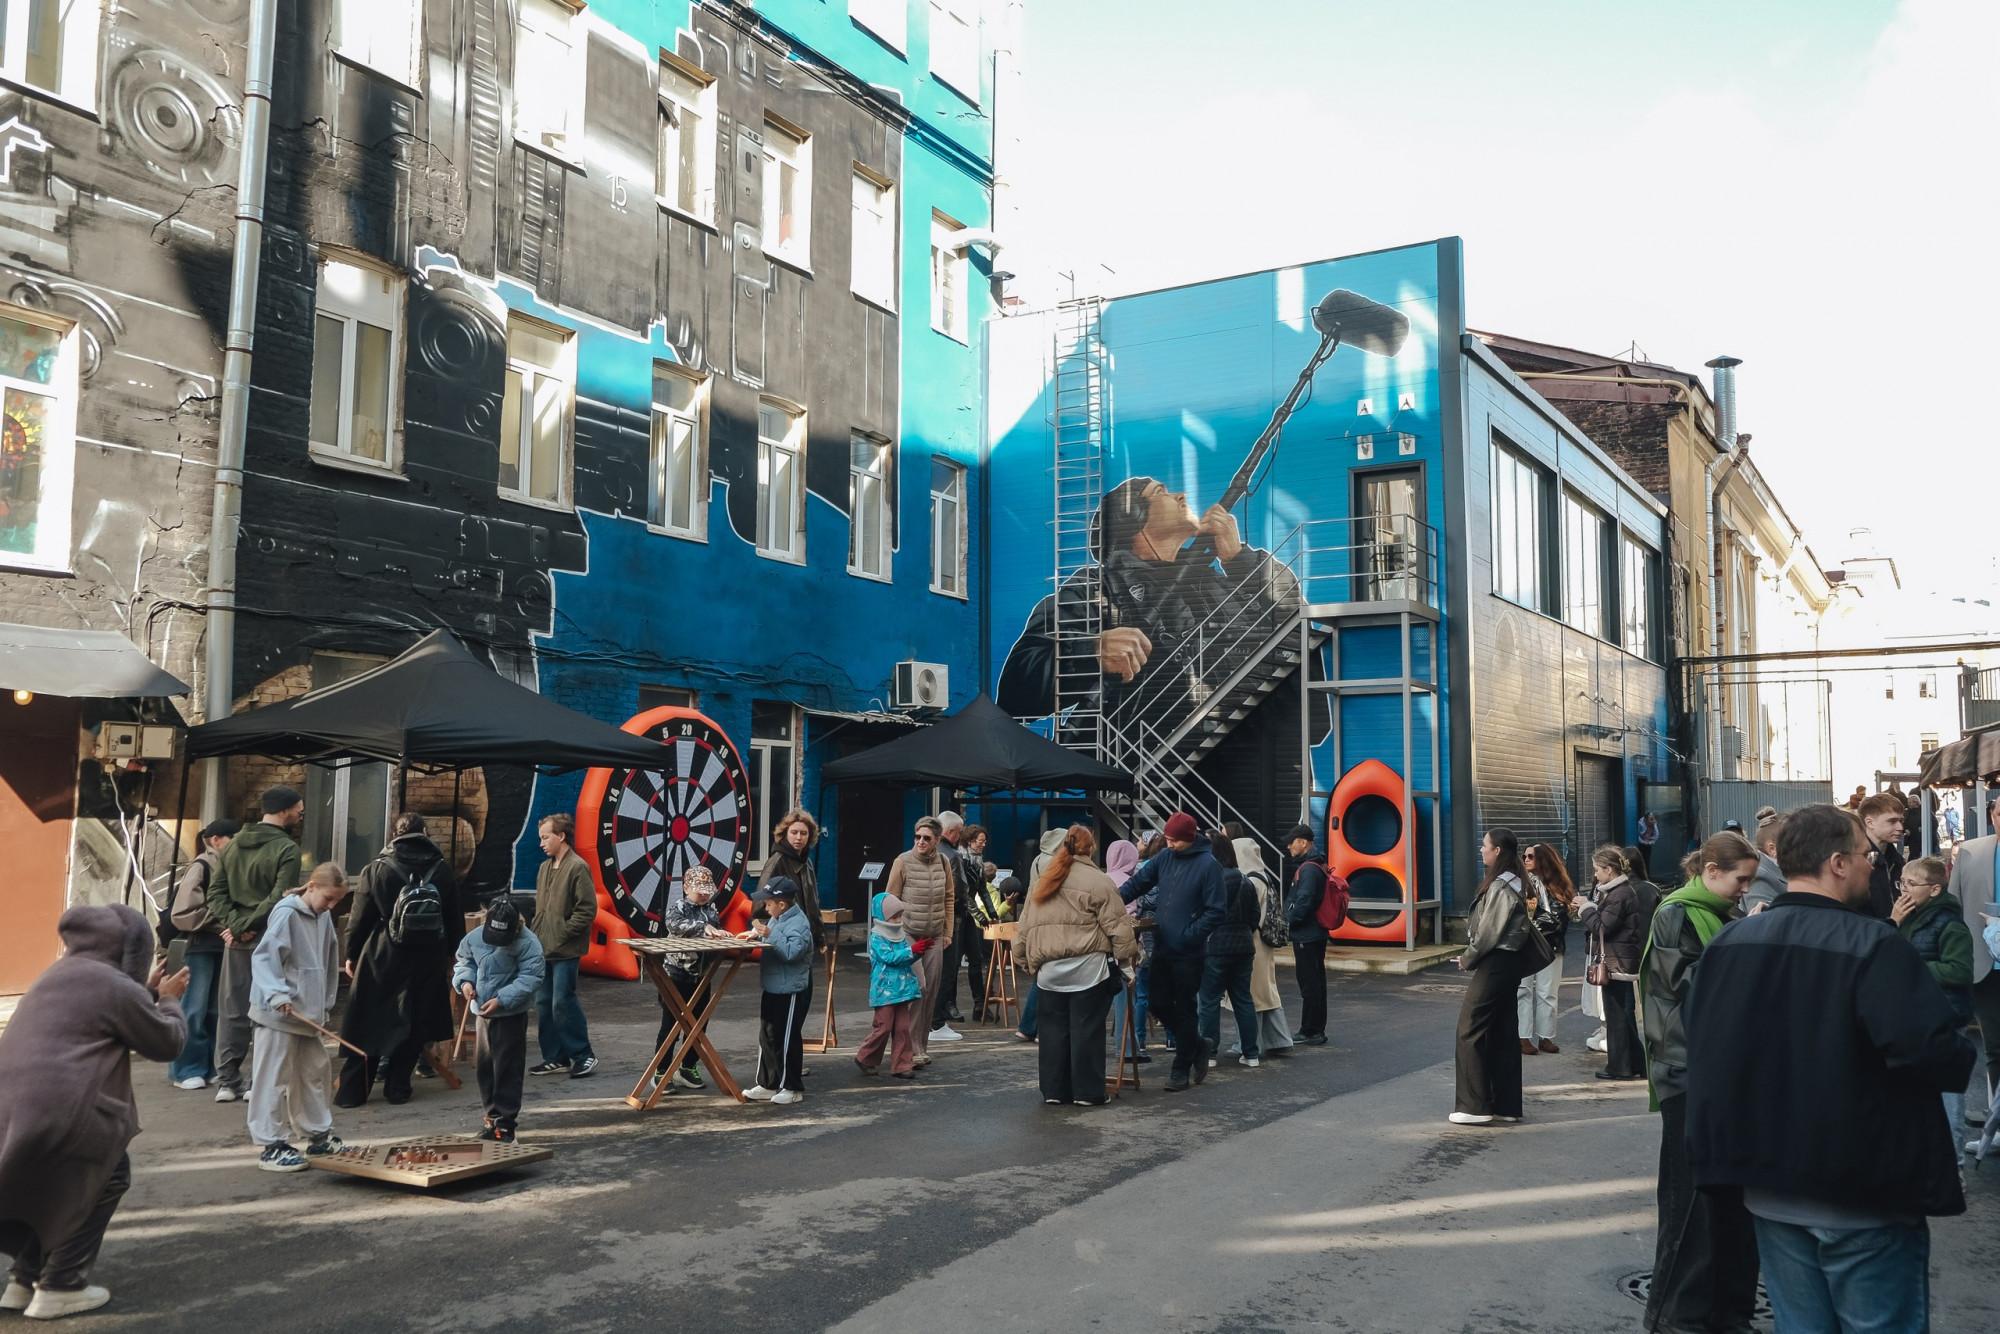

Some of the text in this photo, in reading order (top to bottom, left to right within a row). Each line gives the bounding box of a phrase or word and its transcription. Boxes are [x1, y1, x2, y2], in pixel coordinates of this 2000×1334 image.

[662, 727, 669, 739] 5
[681, 724, 692, 736] 20
[704, 730, 709, 743] 1
[608, 787, 620, 802] 14
[603, 822, 613, 836] 11
[604, 857, 614, 867] 8
[735, 851, 744, 864] 10
[614, 883, 625, 900] 16
[629, 907, 638, 918] 7
[648, 920, 659, 933] 19
